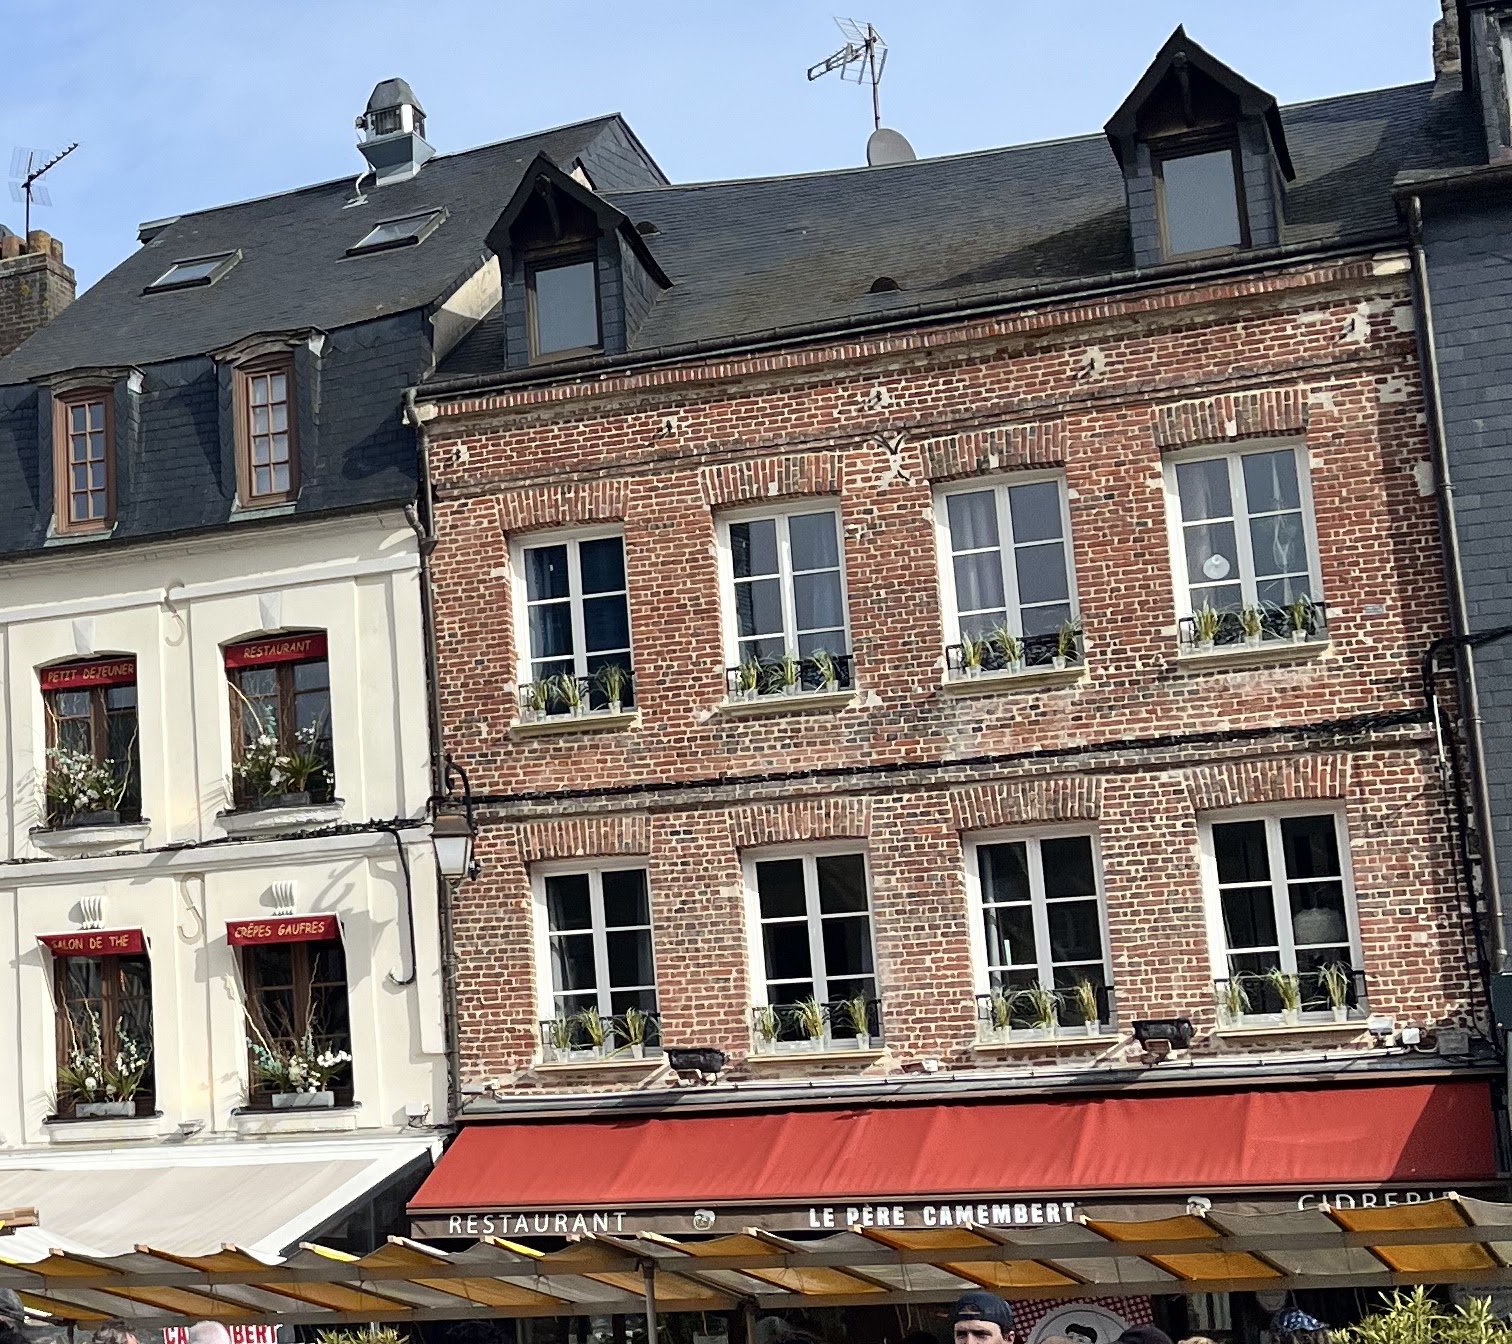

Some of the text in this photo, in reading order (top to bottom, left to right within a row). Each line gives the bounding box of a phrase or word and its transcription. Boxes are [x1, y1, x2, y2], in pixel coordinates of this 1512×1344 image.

[243, 640, 311, 658] RESTAURANT
[47, 669, 76, 683] PETIT
[234, 921, 325, 938] CRÊPES GAUFRES
[51, 937, 84, 950] SALON
[89, 936, 104, 949] DE
[448, 1212, 627, 1234] RESTAURANT
[809, 1202, 1076, 1228] LE PÈRE CAMEMBERT
